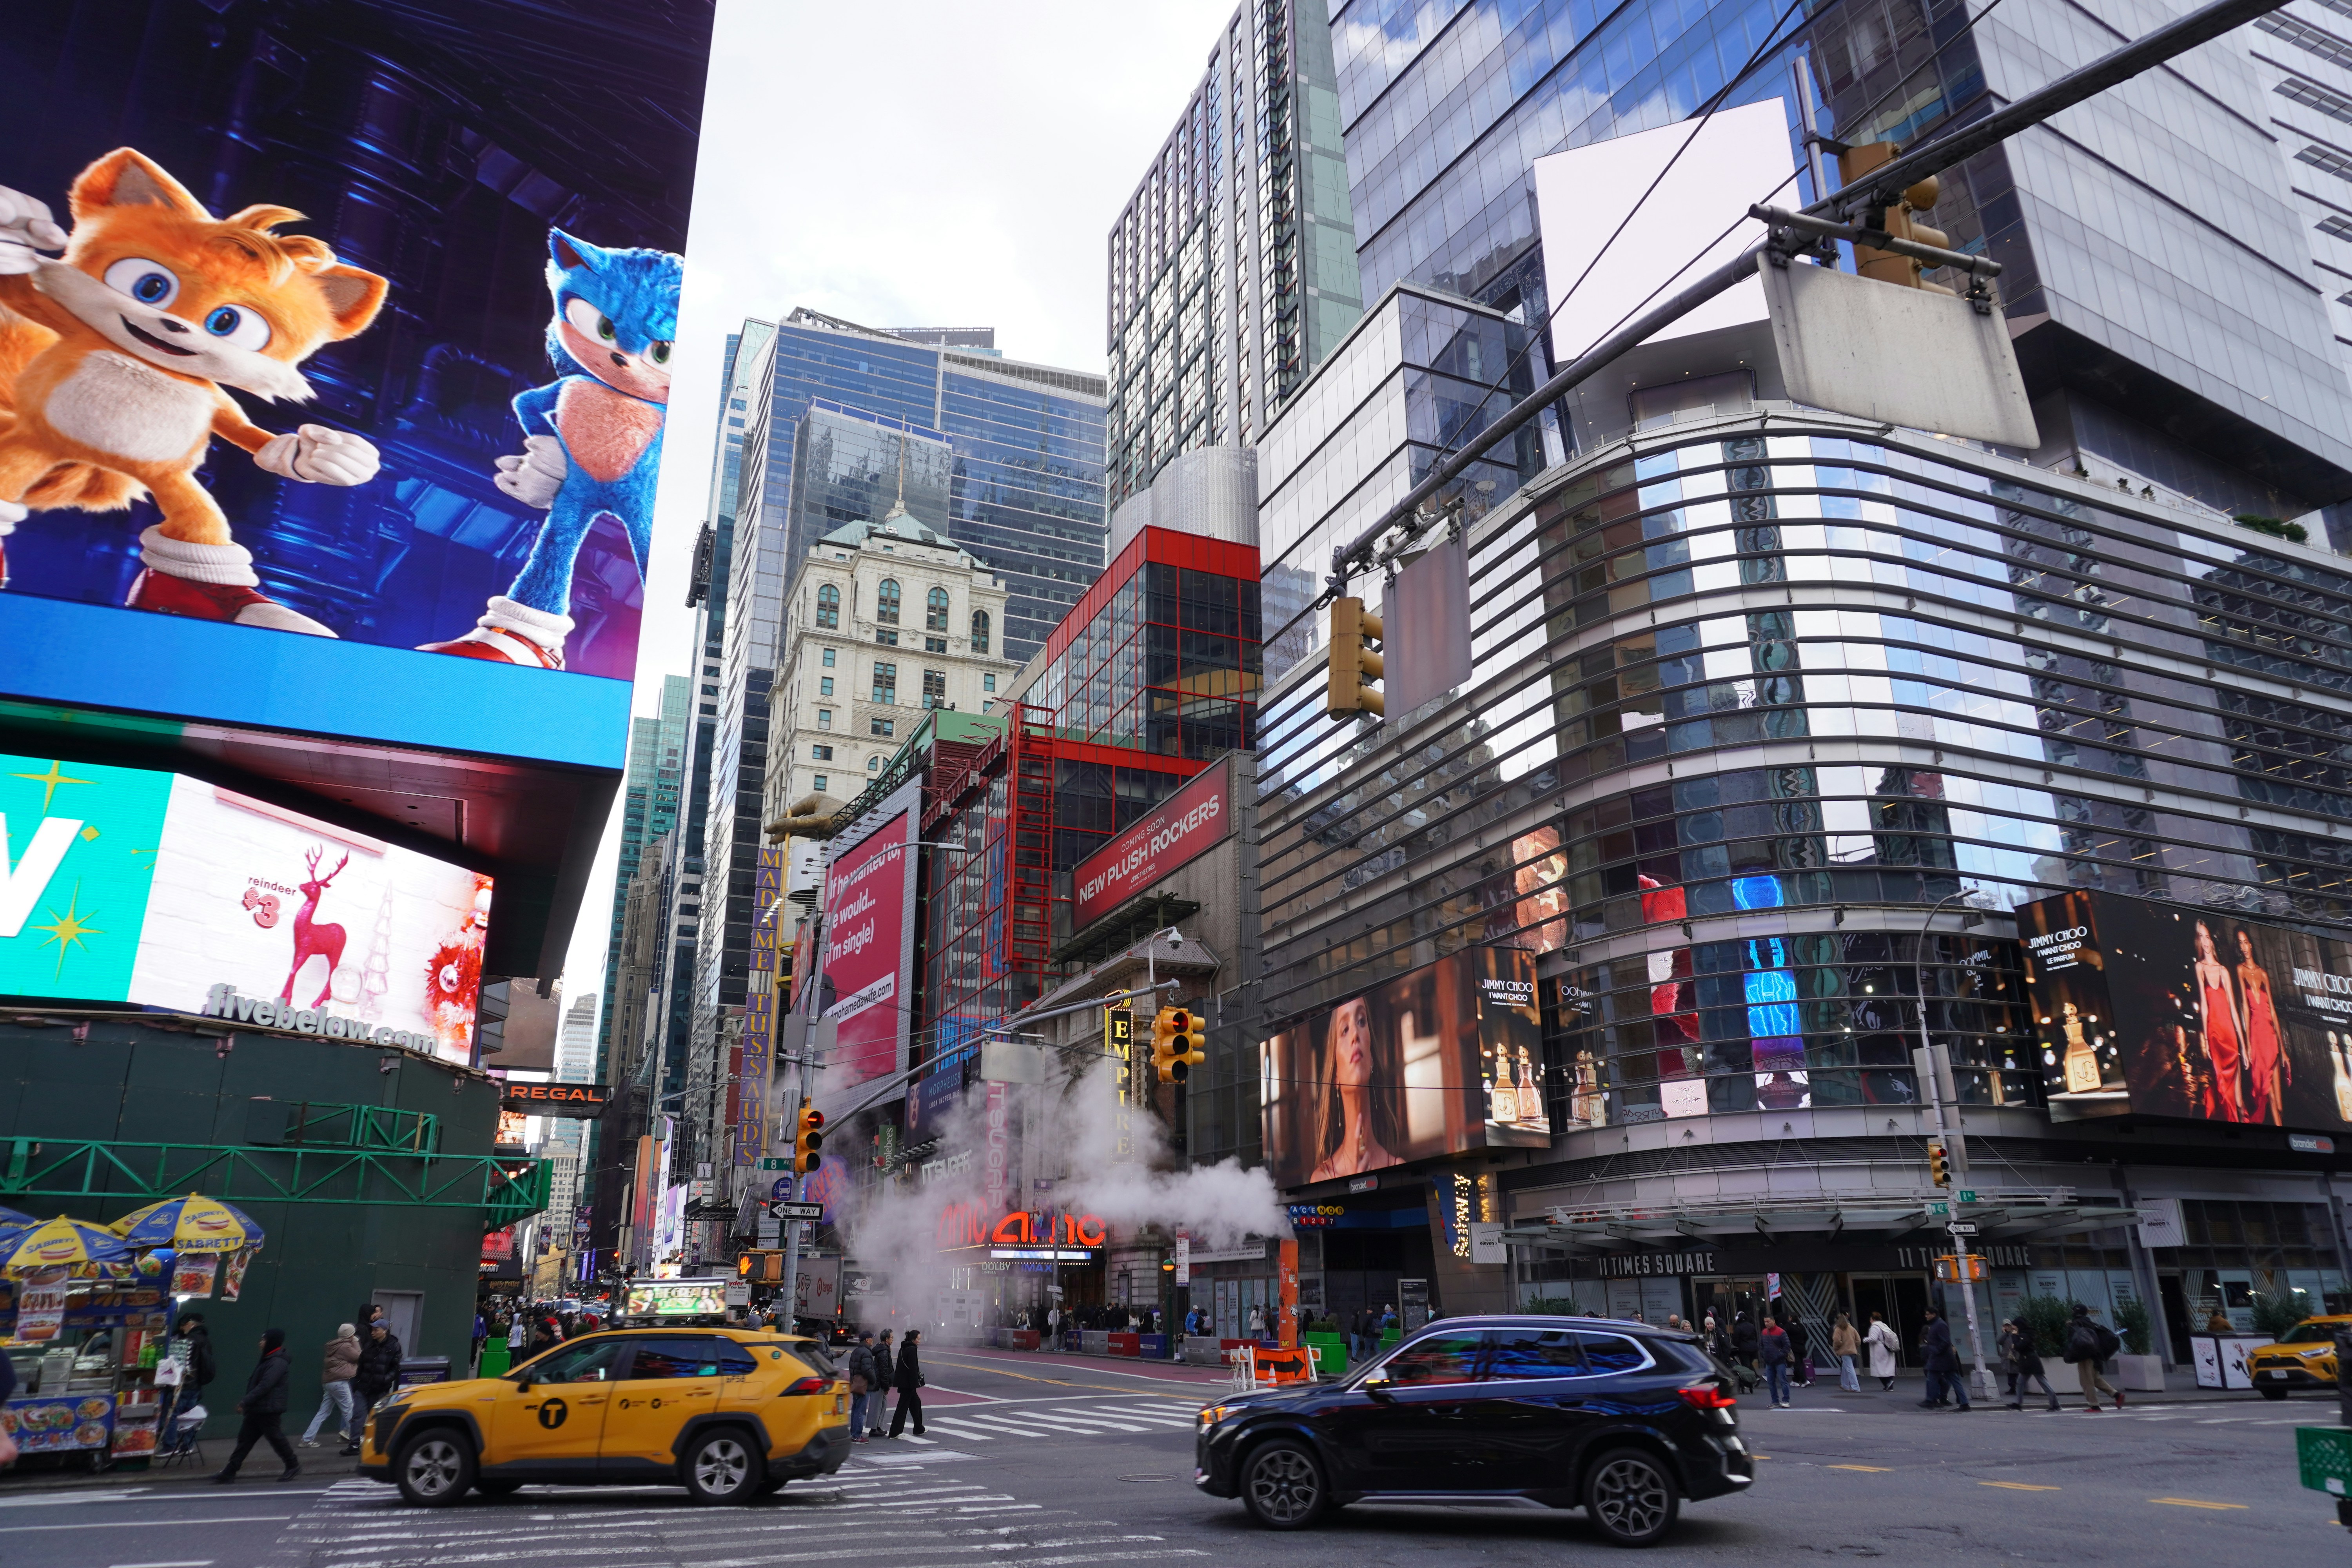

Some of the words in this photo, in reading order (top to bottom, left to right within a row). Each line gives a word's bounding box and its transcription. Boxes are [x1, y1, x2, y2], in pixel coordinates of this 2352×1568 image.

[1121, 830, 1145, 853] COMING
[1147, 815, 1165, 835] SOON
[1080, 872, 1106, 905] NEW
[1108, 842, 1148, 886] PLUSH
[1151, 795, 1219, 857] ROCKERS
[829, 877, 837, 900] If
[837, 875, 849, 895] he
[850, 843, 886, 886] wanted
[887, 842, 901, 861] to,
[248, 876, 296, 897] reindeer
[242, 887, 281, 929] $3
[754, 850, 780, 969] MADAME
[840, 887, 876, 924] would...
[826, 942, 841, 968] (I'm
[843, 917, 874, 955] single)
[2028, 933, 2054, 949] JIMMY
[2055, 926, 2087, 942] CHOO
[2040, 946, 2058, 956] WANT
[2058, 941, 2082, 952] CHOO
[2053, 953, 2076, 963] PARFUM
[1482, 979, 1505, 990] JIMMY
[1506, 981, 1534, 992] CHOO
[2292, 967, 2323, 989] JIMMY
[1508, 993, 1528, 1002] CHOO
[2305, 994, 2310, 1006] I
[2308, 995, 2331, 1010] WANT
[208, 983, 439, 1058] fivebelow.com
[740, 994, 769, 1165] TUSSAUD'S
[929, 1071, 961, 1097] MORPHEUS8
[1113, 1020, 1131, 1154] EMPIRE
[510, 1086, 603, 1102] REGAL
[929, 1099, 938, 1109] LOOK
[938, 1089, 960, 1104] INCREDIBLE
[881, 1127, 895, 1173] Applebee's
[987, 1082, 1005, 1209] IT'SUGAR
[771, 1159, 777, 1169] 8
[922, 1150, 971, 1185] IT'SUGAR
[1963, 1192, 1967, 1200] 8
[183, 1210, 225, 1225] SABRETT
[1937, 1203, 1944, 1213] 42
[936, 1196, 987, 1247] amc
[25, 1238, 75, 1254] SABRETT
[176, 1237, 241, 1249] SABRETT
[1021, 1263, 1053, 1273] IMAX
[1599, 1258, 1607, 1276] 11
[1612, 1256, 1650, 1275] TIMES
[1656, 1253, 1715, 1274] SQUARE
[1898, 1247, 1913, 1267] 11
[489, 1281, 504, 1289] Harry
[822, 1281, 833, 1295] target
[545, 1404, 563, 1426] T
